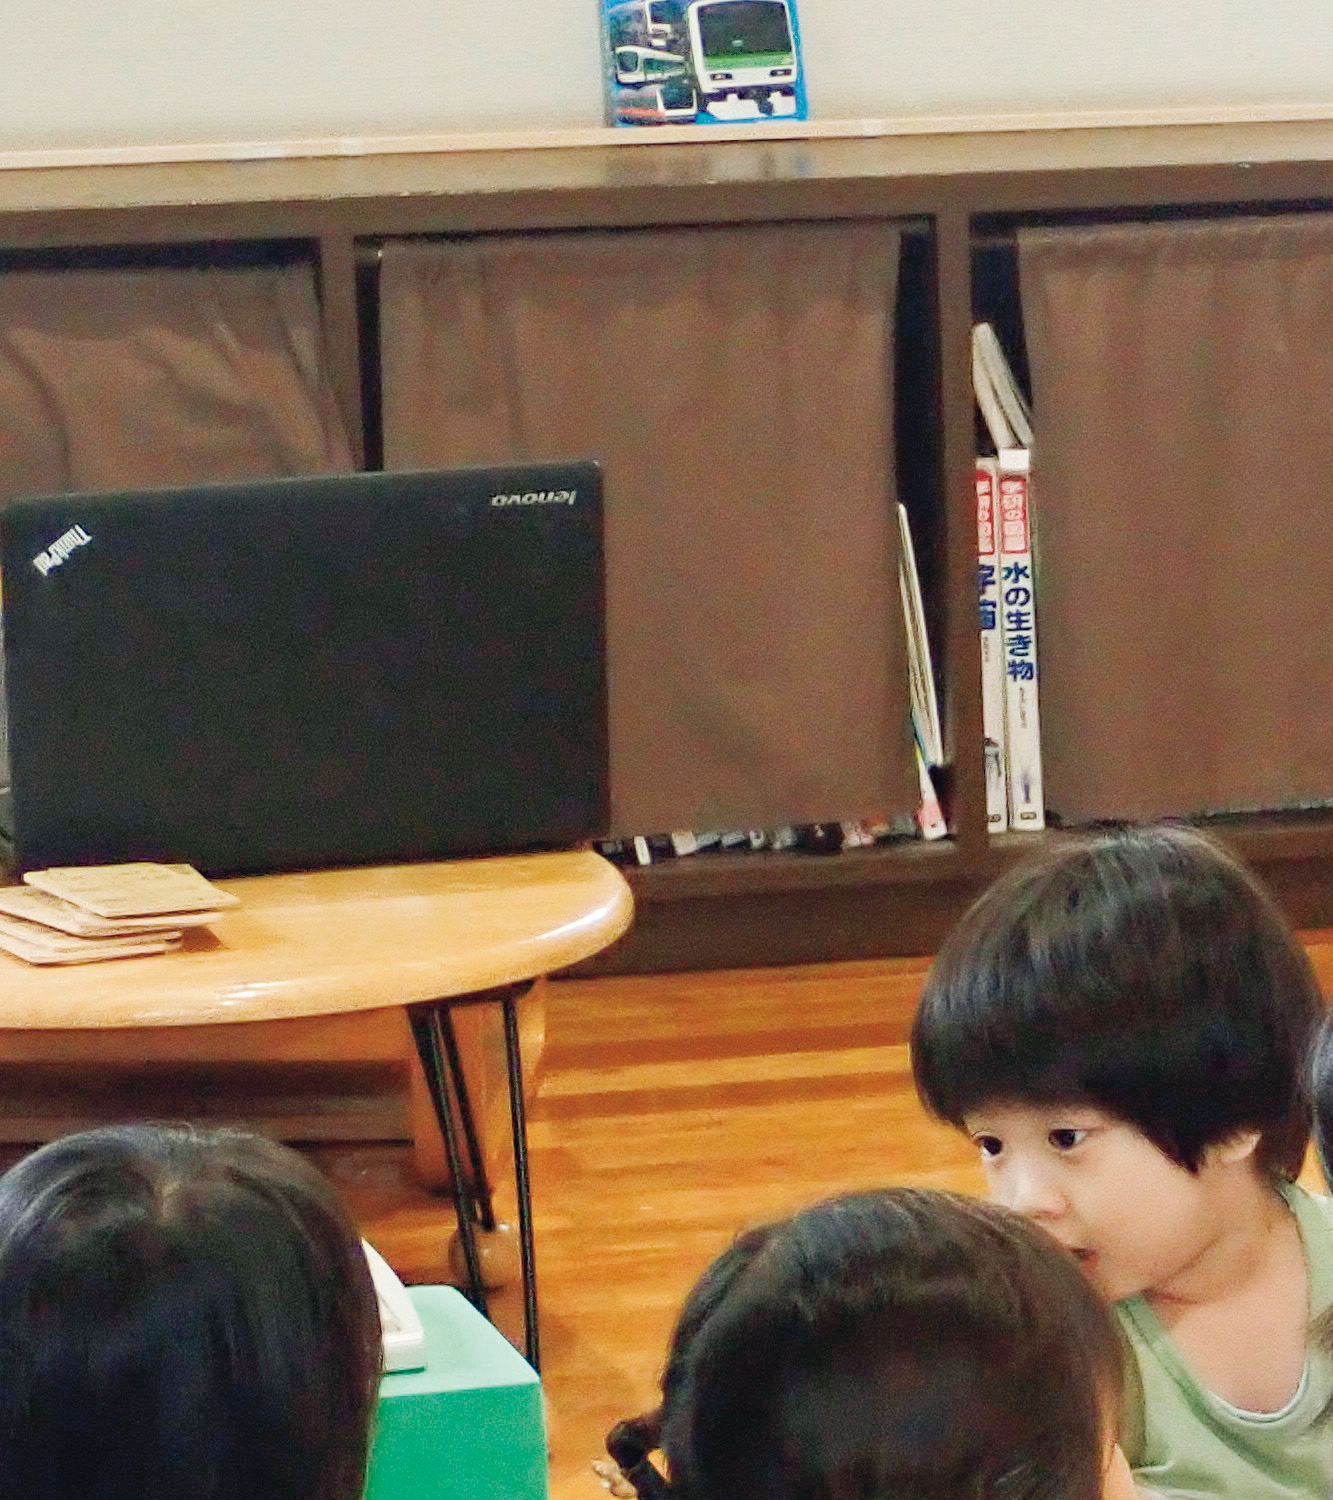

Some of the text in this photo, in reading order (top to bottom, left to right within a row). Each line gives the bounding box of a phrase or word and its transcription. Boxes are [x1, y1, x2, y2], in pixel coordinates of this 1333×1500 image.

[491, 489, 577, 508] lenovo
[1001, 561, 1035, 682] 水の生き物
